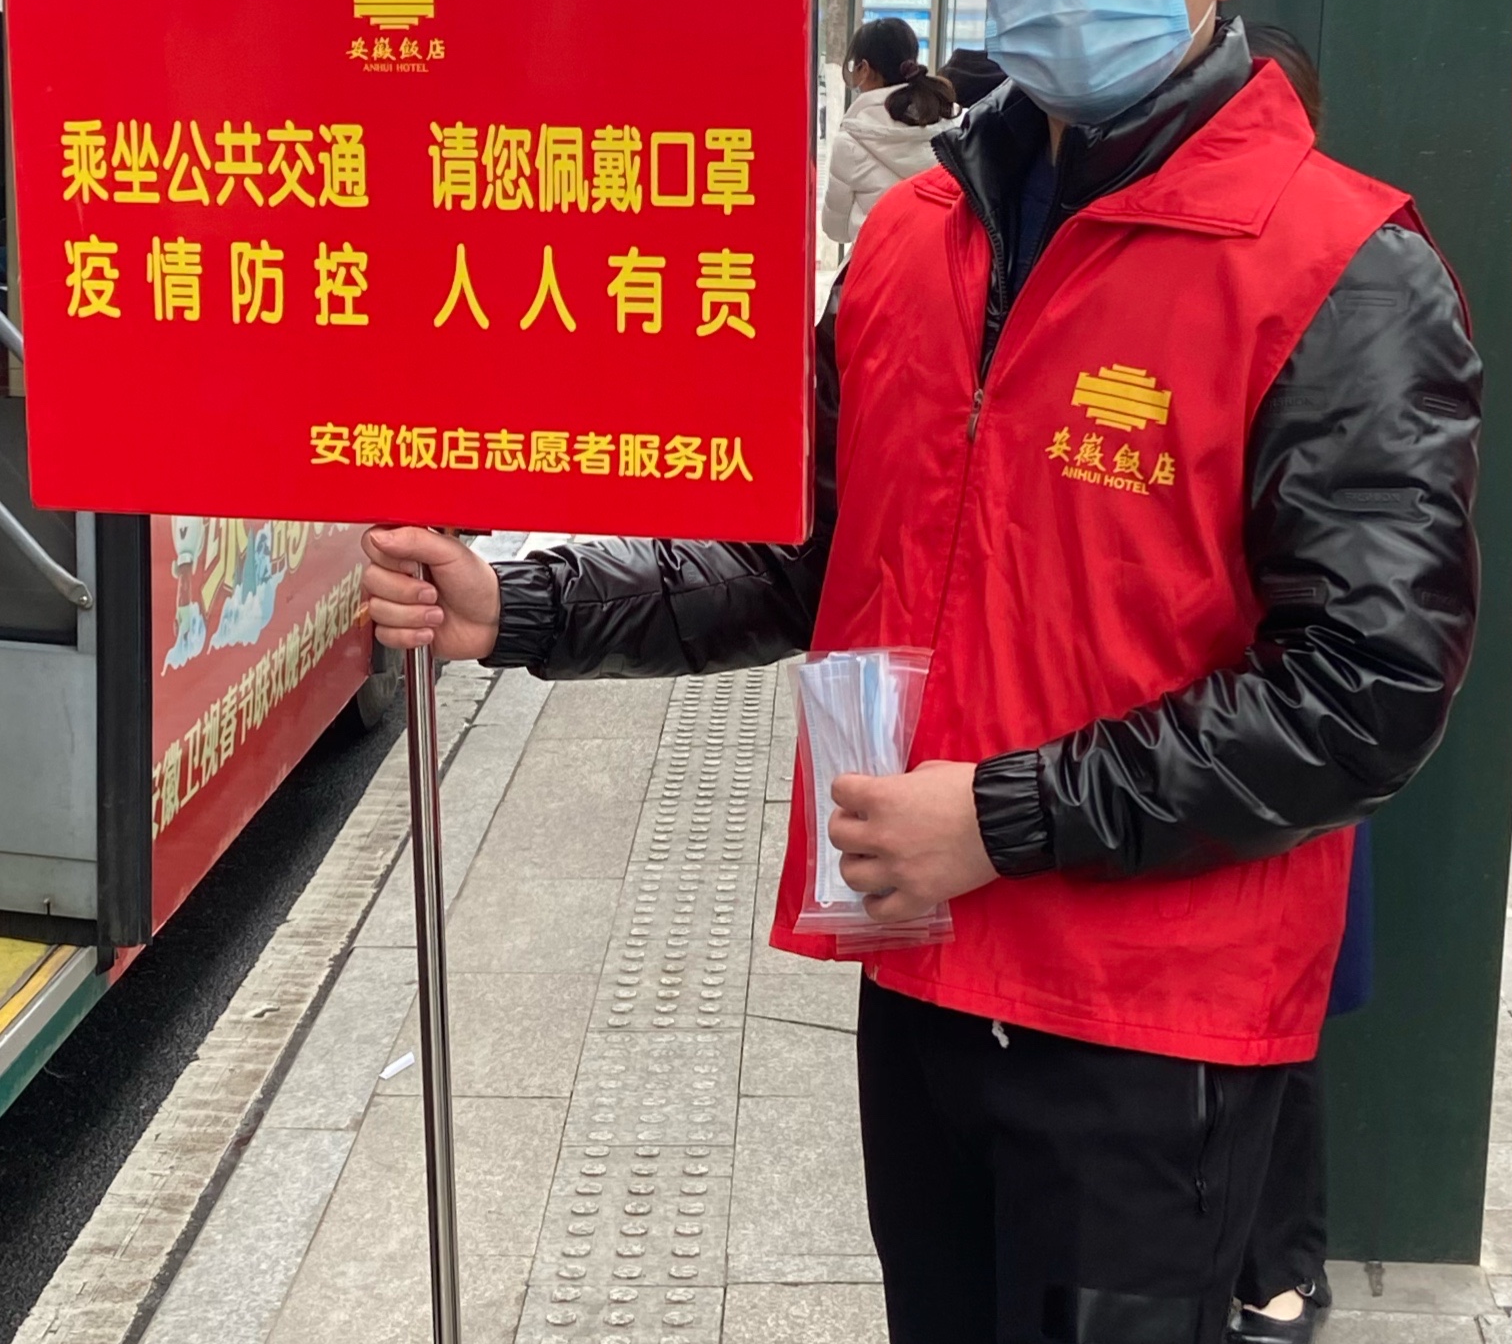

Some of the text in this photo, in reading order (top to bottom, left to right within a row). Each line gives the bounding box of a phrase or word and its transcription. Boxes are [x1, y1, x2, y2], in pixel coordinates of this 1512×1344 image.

[363, 63, 429, 73] ANHUI HOTEL
[60, 118, 756, 216] 乘坐公共交通 请您佩戴口罩
[64, 233, 757, 339] 疫情防控 人人有责
[309, 421, 754, 482] 安徽饭店志愿者服务队
[1061, 465, 1150, 496] ANHUI HOTEL
